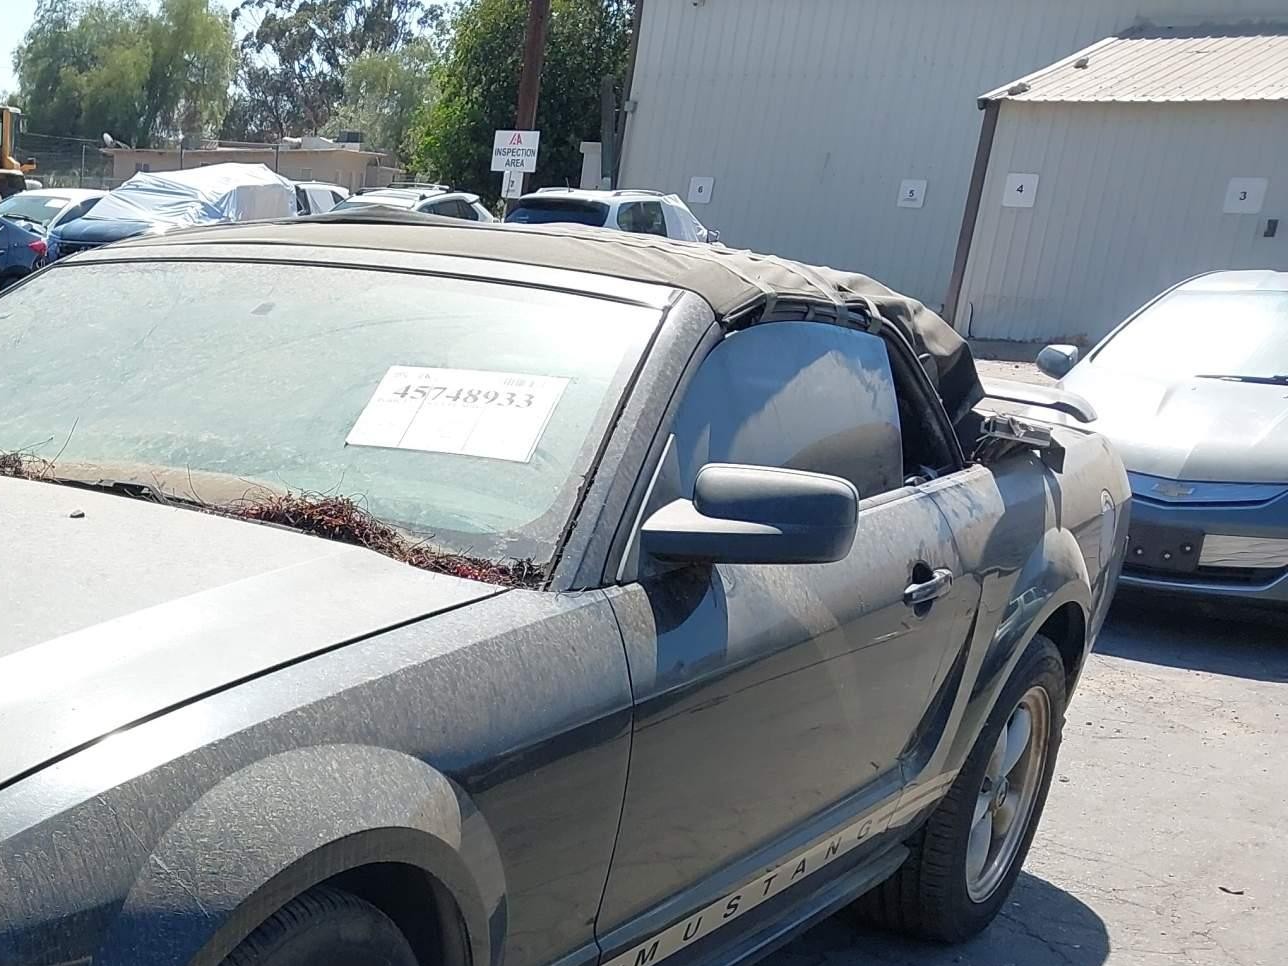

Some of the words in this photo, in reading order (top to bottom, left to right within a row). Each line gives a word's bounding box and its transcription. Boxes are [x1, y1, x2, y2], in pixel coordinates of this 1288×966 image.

[495, 148, 536, 157] INSPECTION
[505, 159, 525, 167] AREA
[697, 186, 703, 194] 6
[1016, 184, 1024, 193] 4
[909, 189, 915, 198] 5
[1239, 191, 1247, 201] 3
[393, 384, 536, 409] 45748933
